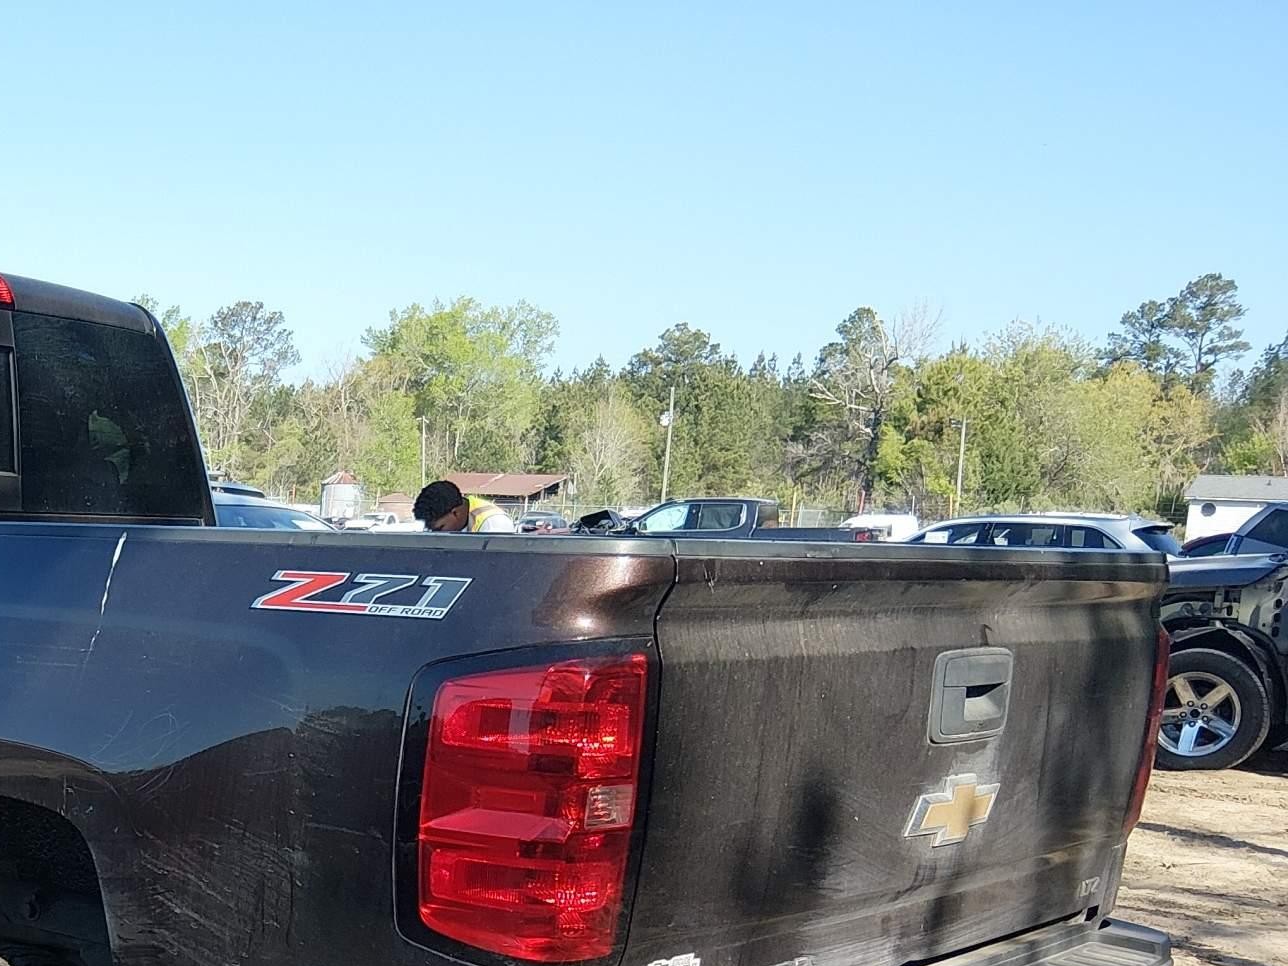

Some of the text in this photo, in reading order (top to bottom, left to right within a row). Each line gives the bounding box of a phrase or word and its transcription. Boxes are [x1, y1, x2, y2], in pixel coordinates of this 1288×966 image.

[250, 569, 473, 609] Z71
[368, 606, 444, 617] OFF ROAD
